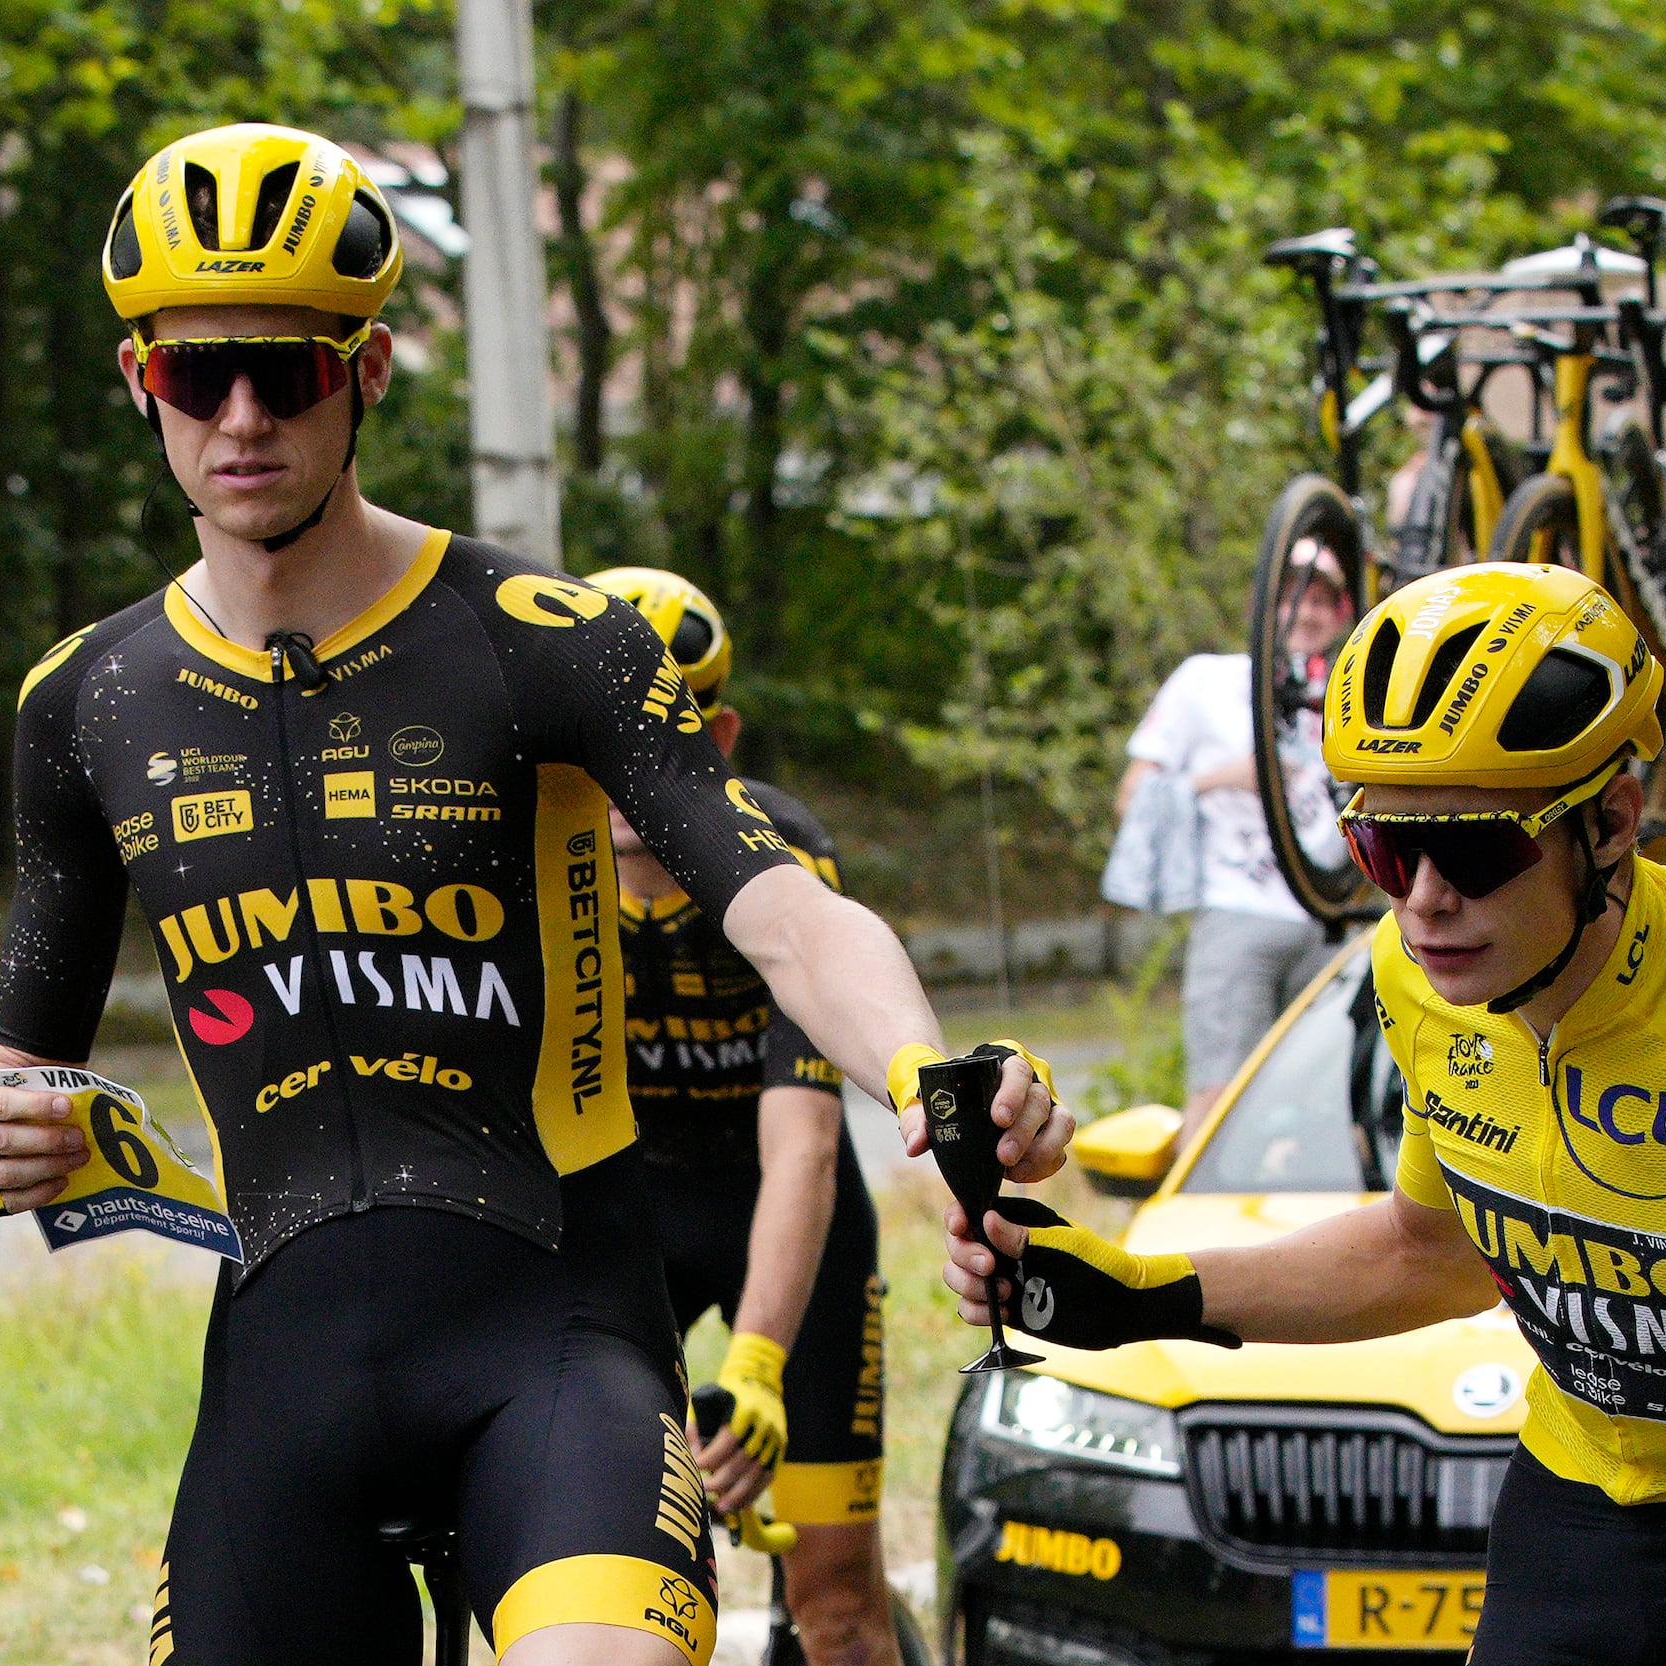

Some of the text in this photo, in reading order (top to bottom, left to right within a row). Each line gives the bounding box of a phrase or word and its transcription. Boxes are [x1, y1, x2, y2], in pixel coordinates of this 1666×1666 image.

[282, 194, 317, 256] JUMBO
[195, 260, 265, 273] LAZER
[1406, 586, 1462, 639] JONAS
[328, 644, 393, 681] VISMA
[1438, 602, 1536, 737] JUMBO VISMA
[1623, 632, 1646, 688] LAZ
[175, 667, 260, 711] JUMBO
[641, 648, 685, 723] JUM
[180, 747, 201, 758] UCI
[321, 745, 370, 762] AGU
[1356, 739, 1422, 754] LAZER
[204, 799, 236, 815] BET
[329, 788, 371, 802] HEMA
[391, 805, 501, 821] SRAM
[205, 811, 244, 829] CITY
[738, 828, 789, 853] HE
[159, 878, 505, 983] JUMBO
[1616, 924, 1650, 986] LCL
[263, 950, 520, 1027] VISMA
[567, 866, 603, 1115] BETCITY.NL
[40, 1070, 90, 1088] VAN
[90, 1093, 159, 1189] 6
[1425, 1089, 1522, 1154] Santini
[87, 1197, 231, 1238] hauts-de-seine
[94, 1212, 207, 1241] Département Sportif
[1570, 1362, 1622, 1391] lease
[1587, 1382, 1626, 1406] bike
[997, 1520, 1123, 1581] JUMBO
